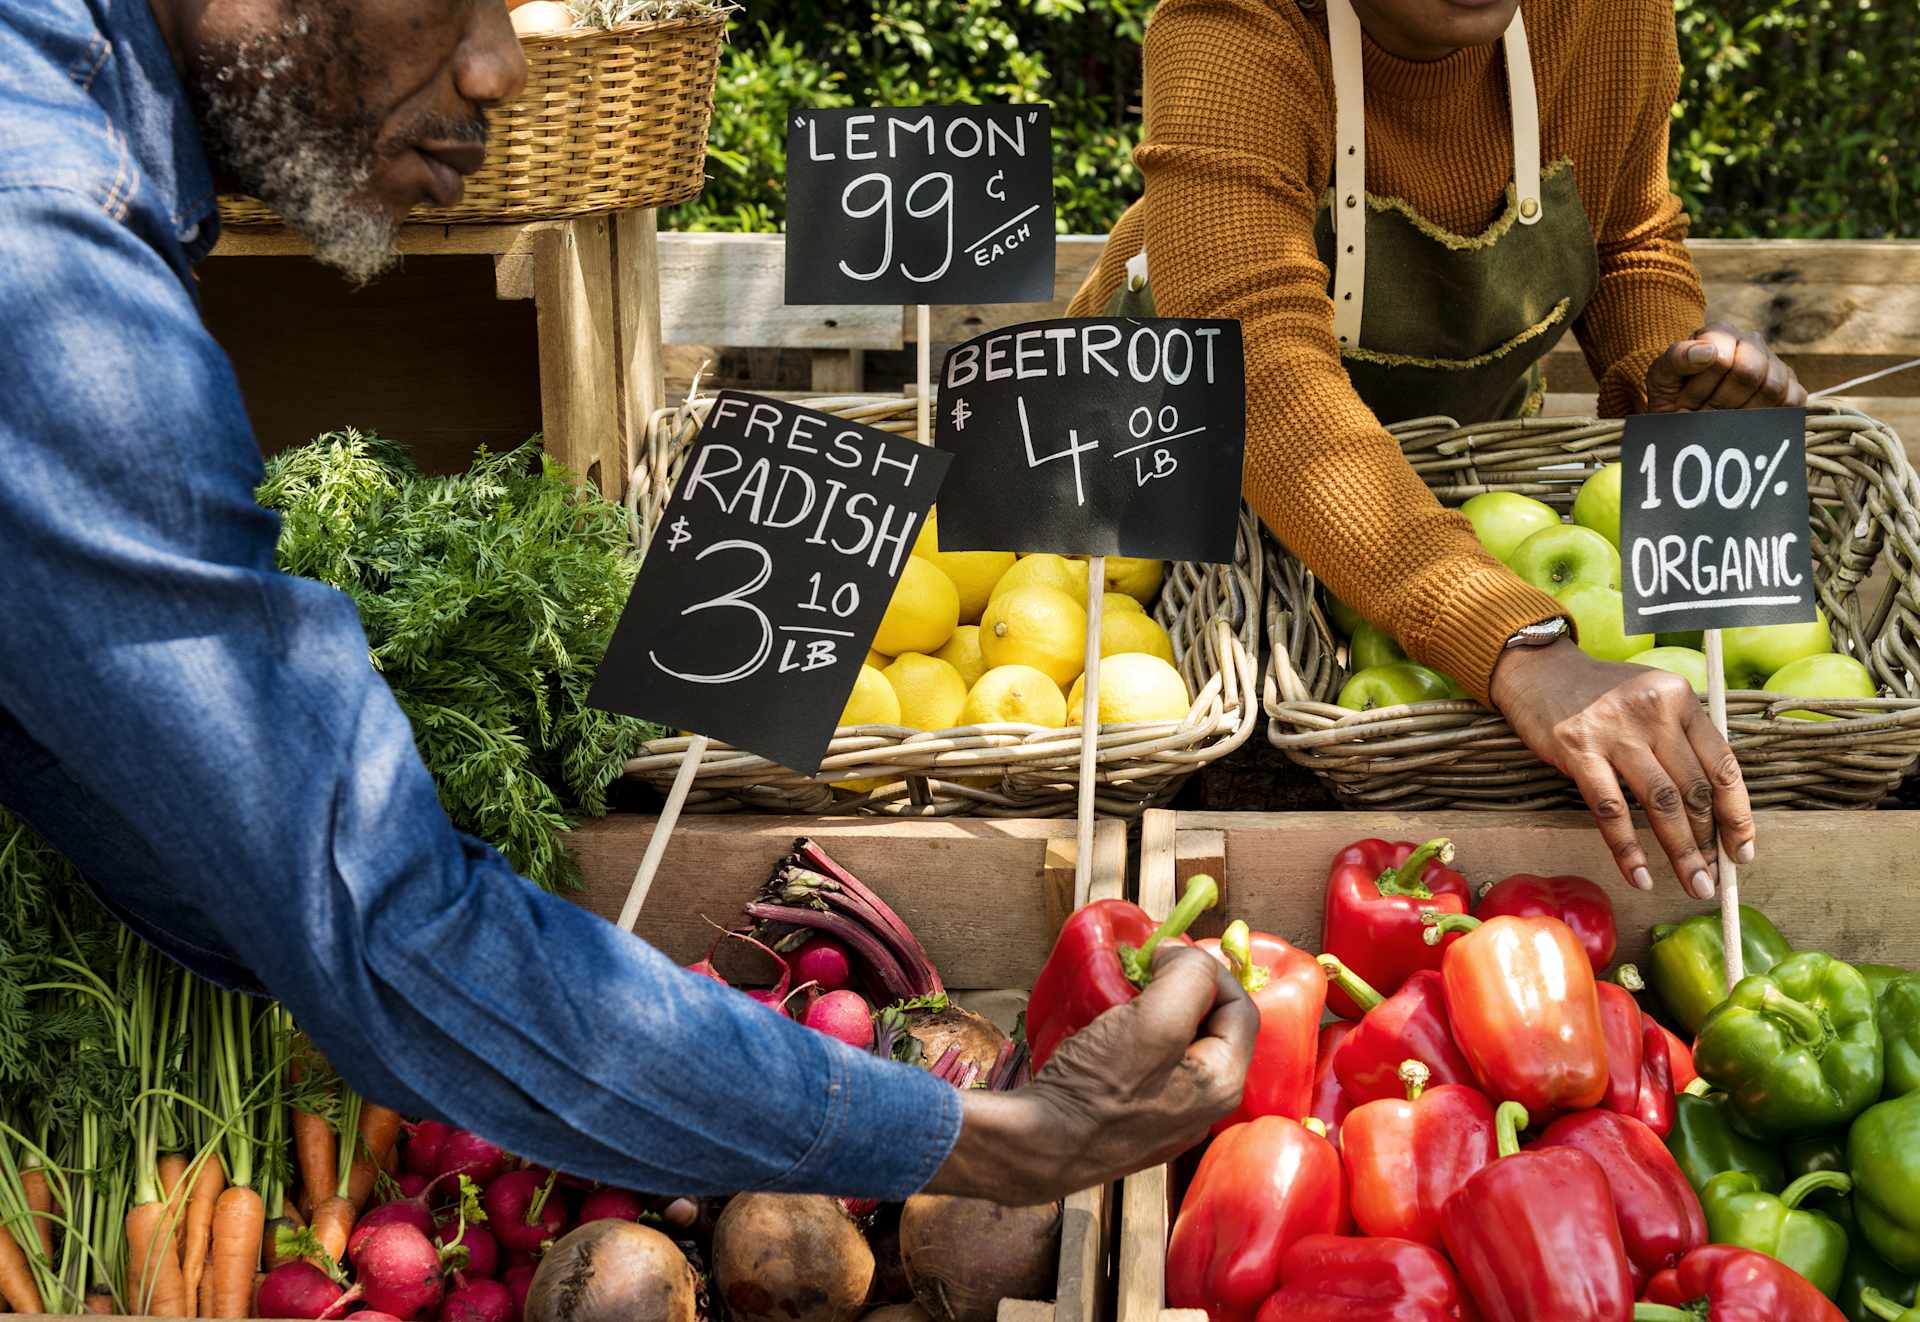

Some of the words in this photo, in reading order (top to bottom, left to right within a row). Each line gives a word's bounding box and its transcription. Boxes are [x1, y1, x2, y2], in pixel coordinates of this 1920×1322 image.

[839, 172, 954, 282] 99
[974, 223, 1031, 266] EACH
[947, 324, 1222, 389] BEETROOT
[711, 398, 919, 487] FRESH
[1136, 449, 1178, 487] LB
[1639, 439, 1791, 509] 100%
[682, 444, 918, 577] RADISH
[798, 572, 860, 618] 10
[1631, 532, 1803, 597] ORGANIC
[778, 639, 838, 673] LB
